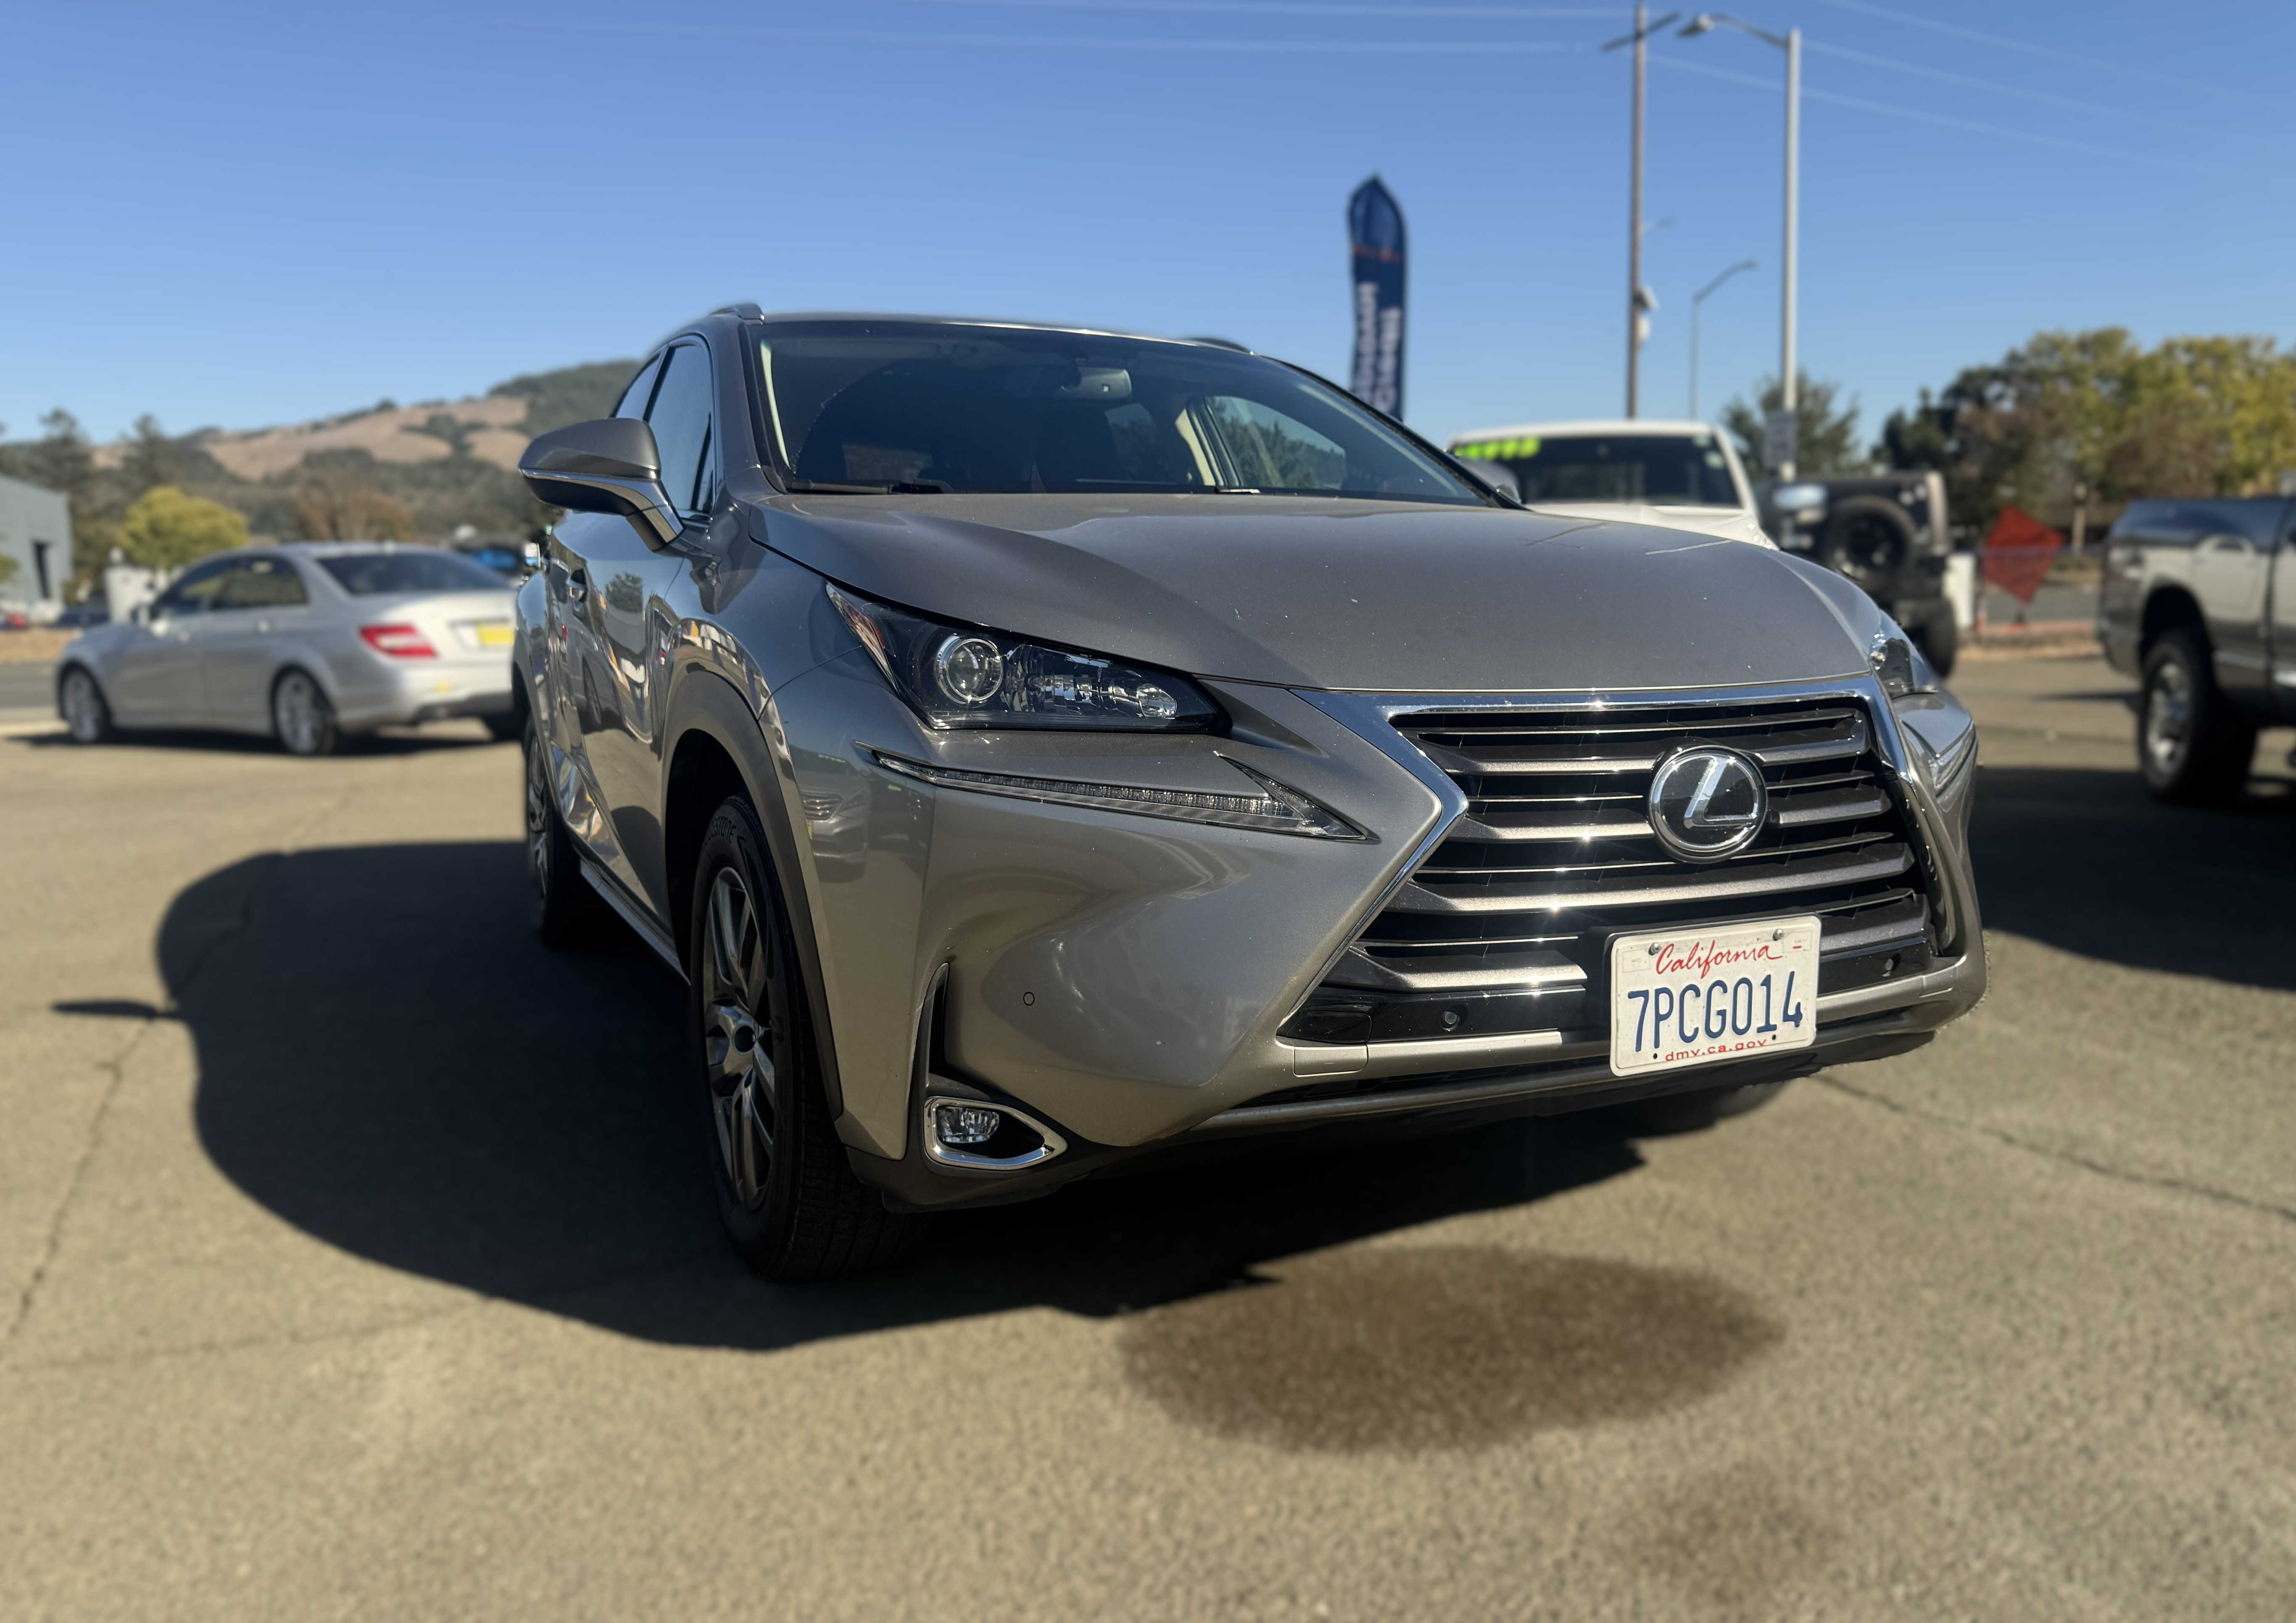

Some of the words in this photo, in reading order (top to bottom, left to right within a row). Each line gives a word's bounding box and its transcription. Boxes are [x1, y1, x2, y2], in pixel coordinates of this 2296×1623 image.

[1656, 939, 1783, 979] California
[1627, 971, 1803, 1052] 7PCG014
[1665, 1039, 1767, 1062] dmv.ca.gov
